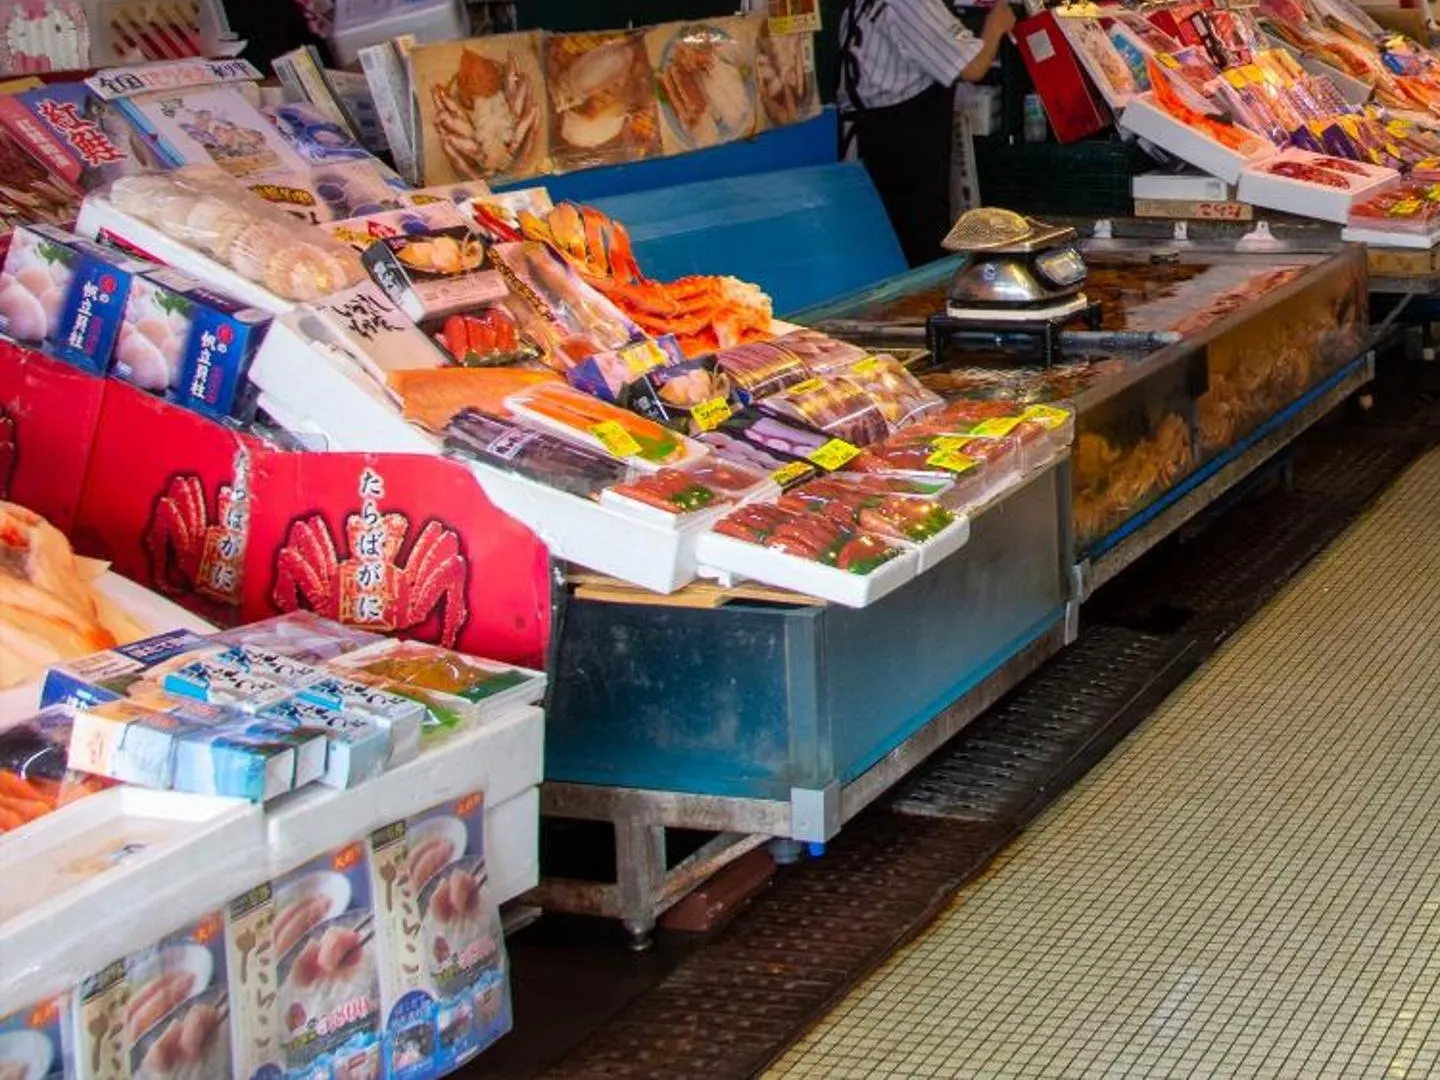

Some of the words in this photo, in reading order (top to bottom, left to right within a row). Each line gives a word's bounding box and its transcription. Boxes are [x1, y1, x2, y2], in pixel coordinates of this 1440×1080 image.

[356, 468, 387, 621] たらばがに
